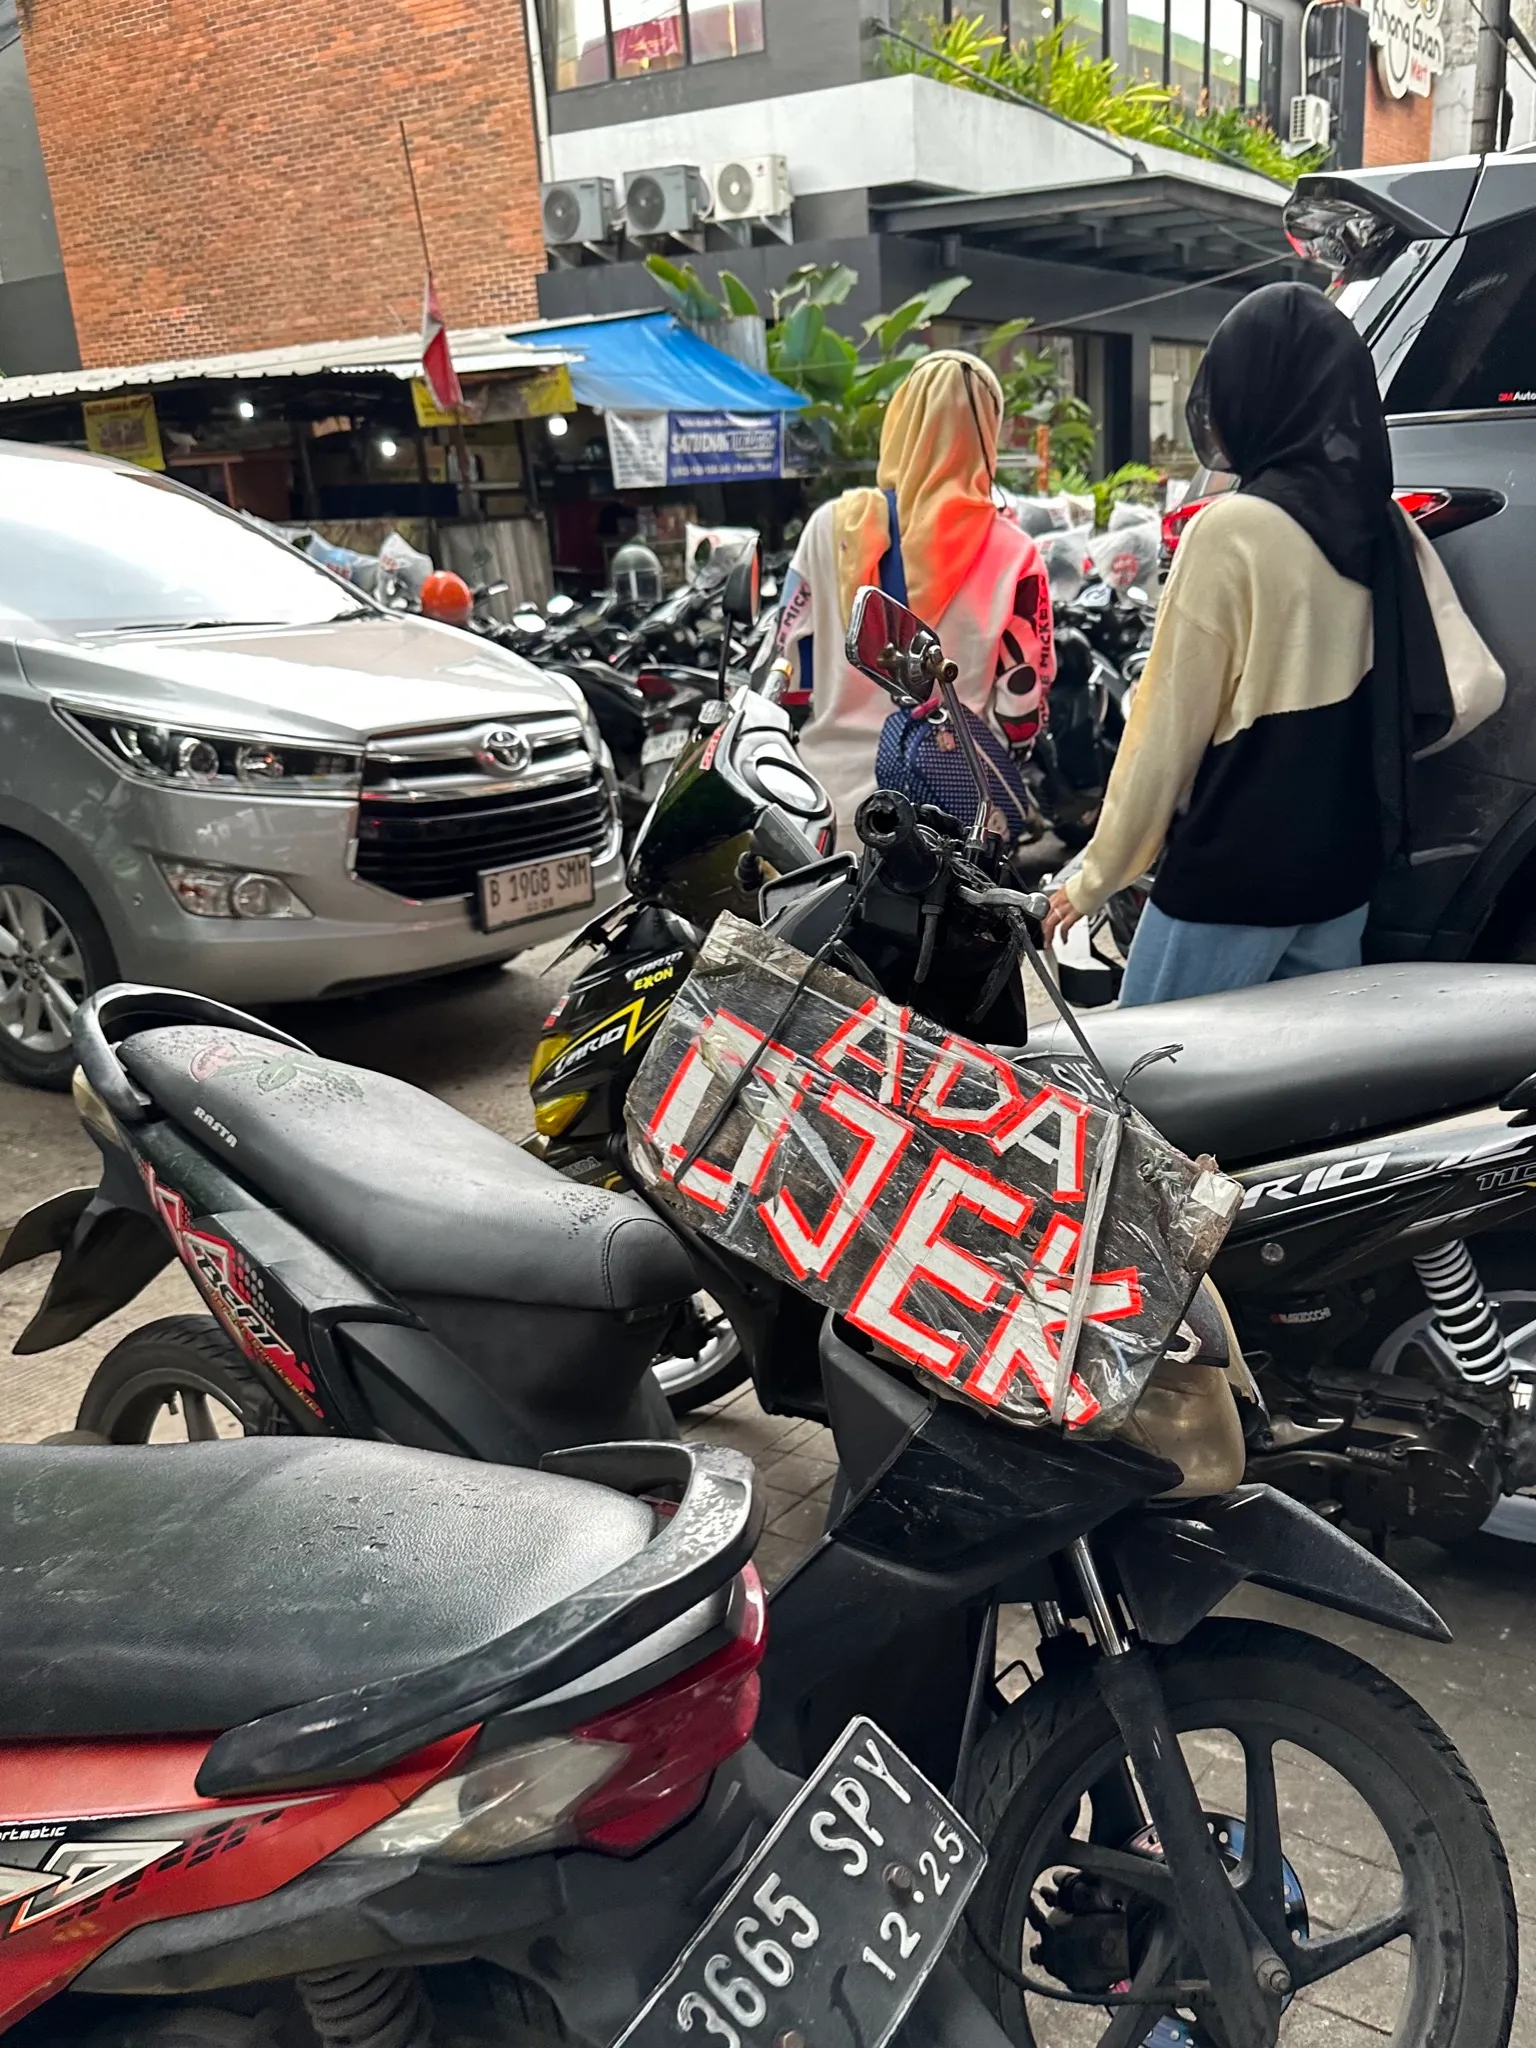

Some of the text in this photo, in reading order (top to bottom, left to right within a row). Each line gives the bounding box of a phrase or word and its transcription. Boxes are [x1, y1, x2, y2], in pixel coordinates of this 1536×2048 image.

[490, 879, 501, 908] B
[556, 857, 589, 890] SMM
[193, 1106, 239, 1148] RASTA
[554, 1024, 628, 1078] VARIO
[814, 996, 1090, 1203] ADA
[645, 1007, 1144, 1431] OJEK
[676, 1738, 912, 2048] 3665 SPY
[861, 1819, 965, 1982] 12.25
